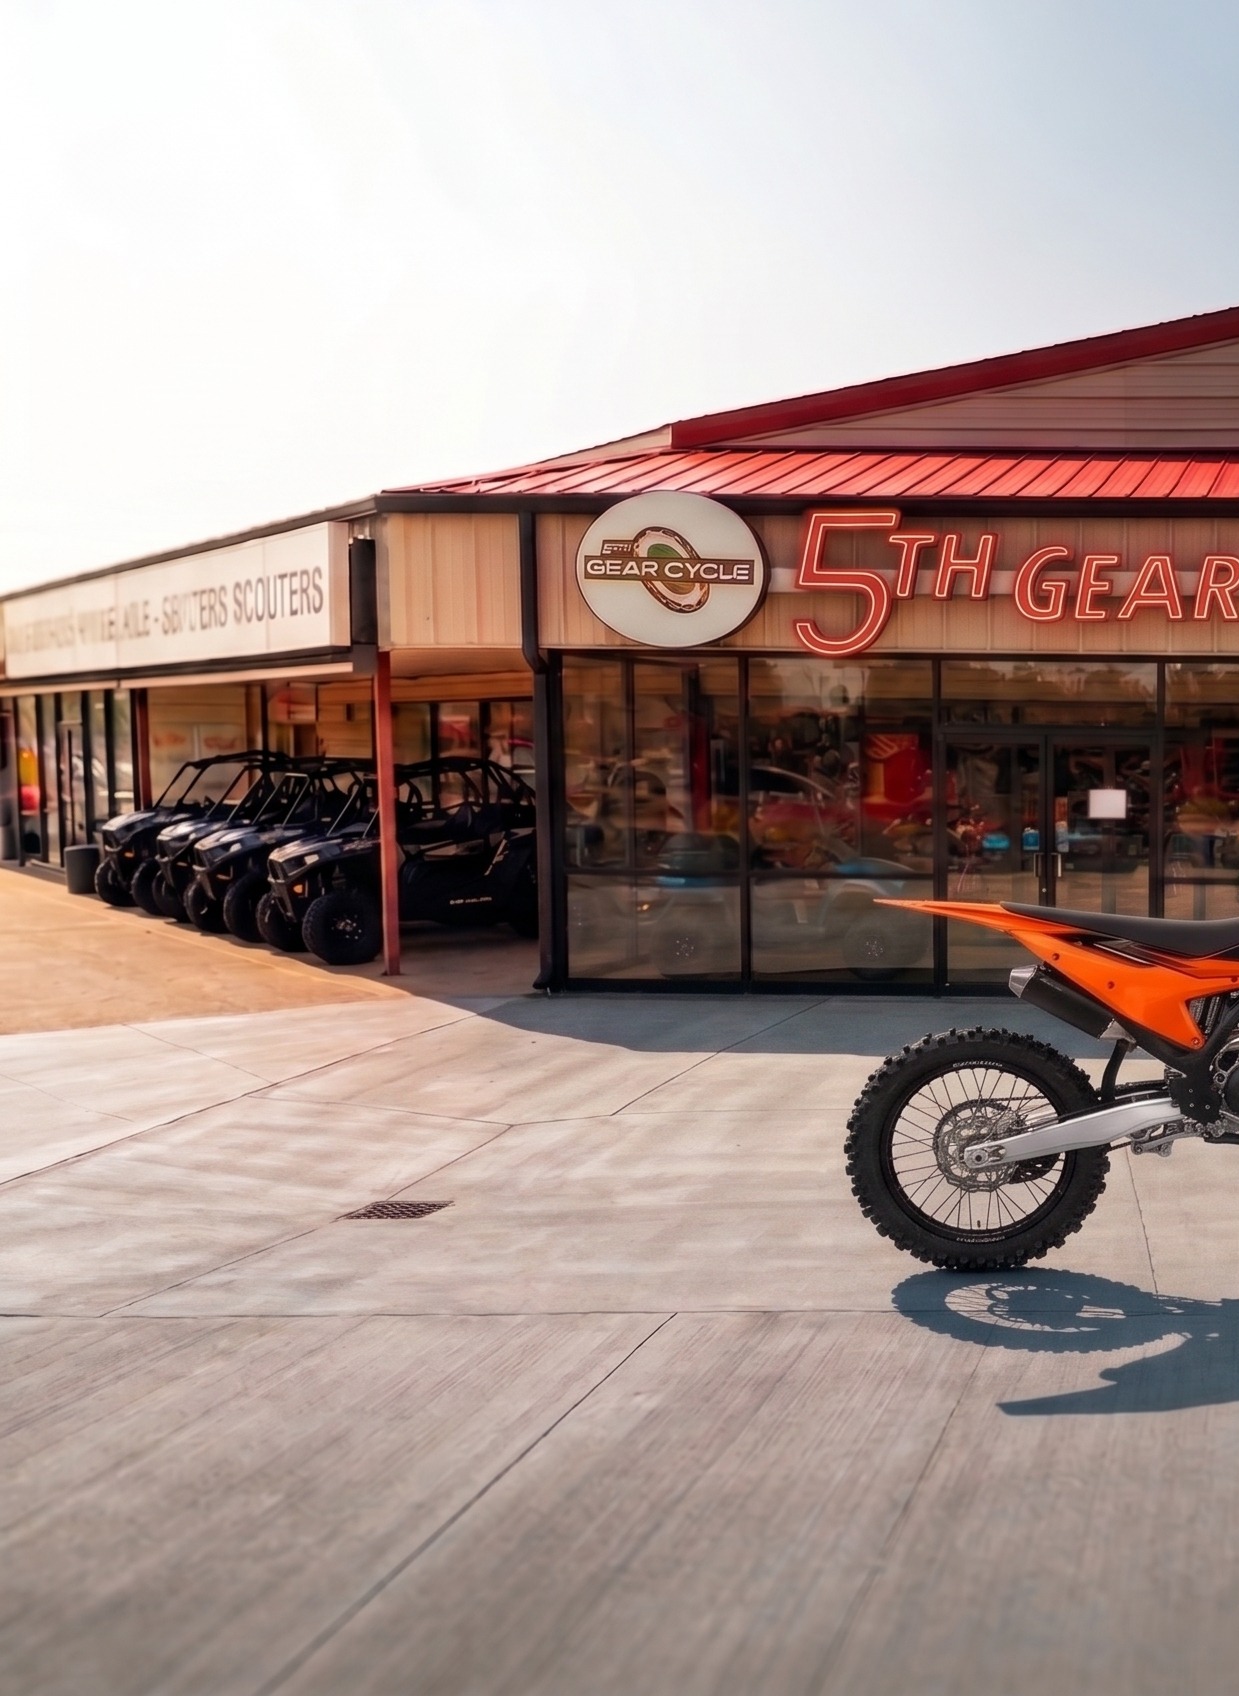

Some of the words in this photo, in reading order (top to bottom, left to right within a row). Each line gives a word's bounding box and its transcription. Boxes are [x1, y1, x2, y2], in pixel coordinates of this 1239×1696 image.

[232, 565, 325, 626] SCOUTERS
[586, 559, 659, 577] GEAR
[664, 562, 750, 580] CYCLE
[793, 510, 996, 657] 5TH
